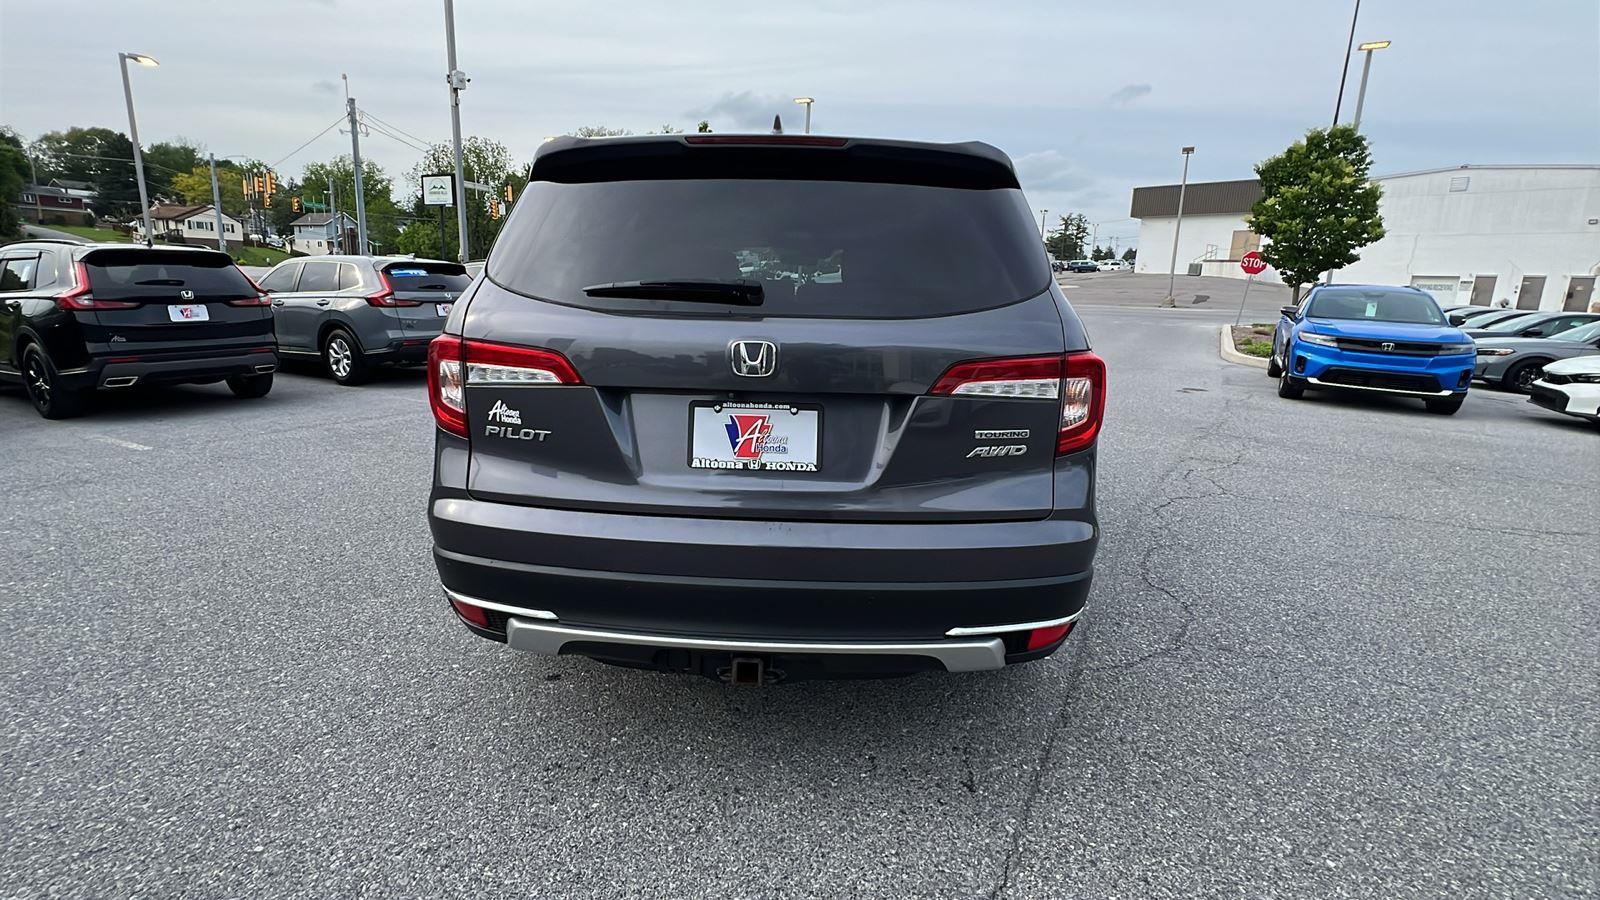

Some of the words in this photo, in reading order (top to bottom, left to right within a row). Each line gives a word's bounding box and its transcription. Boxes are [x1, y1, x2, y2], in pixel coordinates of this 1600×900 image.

[1242, 257, 1267, 269] STOP
[722, 401, 791, 410] altoonahonda.com
[501, 414, 522, 425] Honda
[484, 425, 552, 442] PILOT
[755, 443, 789, 454] Honda
[965, 445, 1028, 458] AWD
[691, 457, 744, 470] Altoona
[765, 462, 819, 472] HONDA
